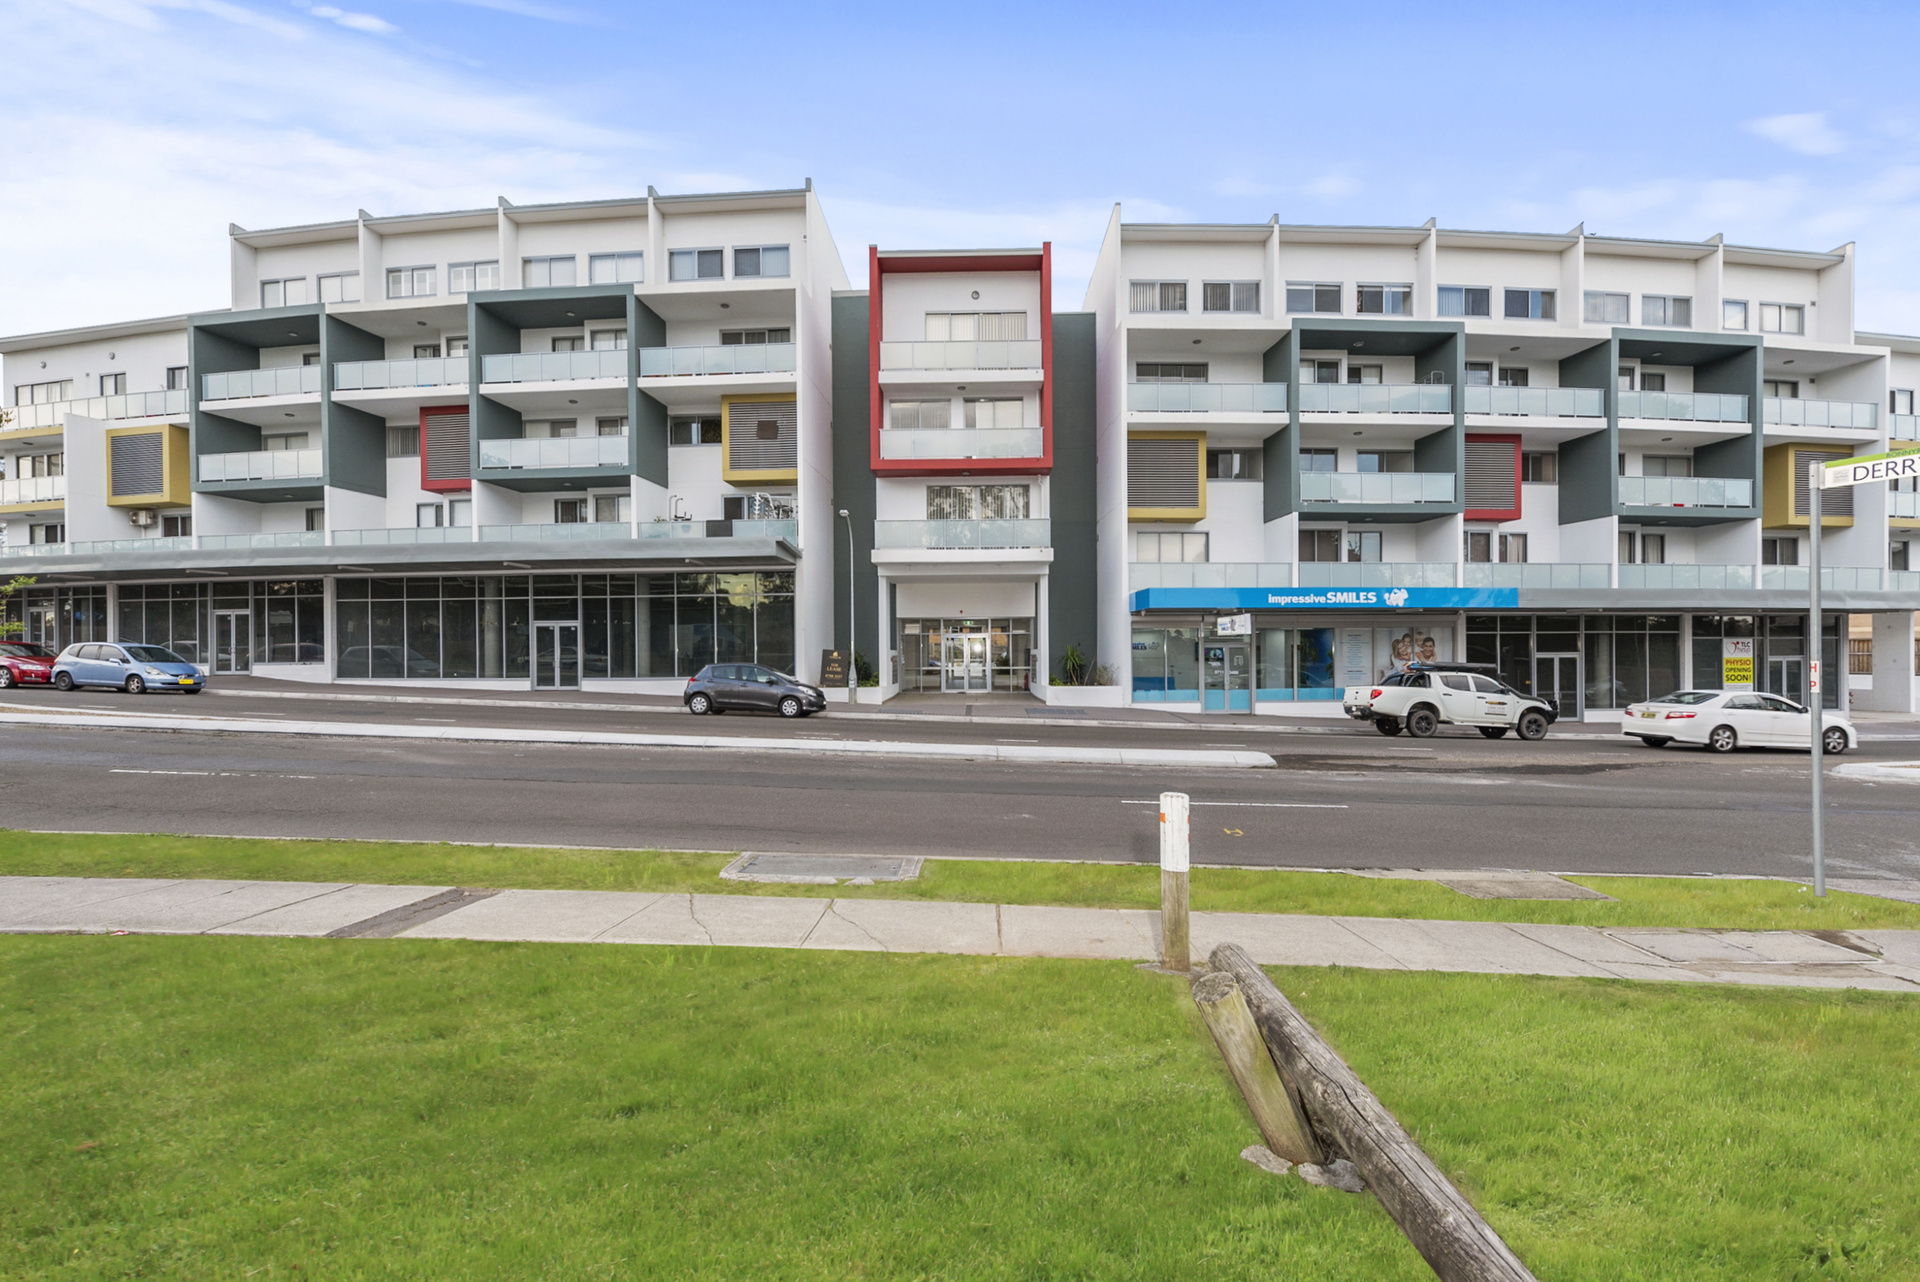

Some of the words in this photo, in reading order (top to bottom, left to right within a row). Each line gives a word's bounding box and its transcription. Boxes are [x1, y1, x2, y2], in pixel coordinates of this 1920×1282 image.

[1853, 456, 1920, 481] DERR
[1268, 594, 1326, 605] impressive
[1326, 592, 1377, 603] SMILES
